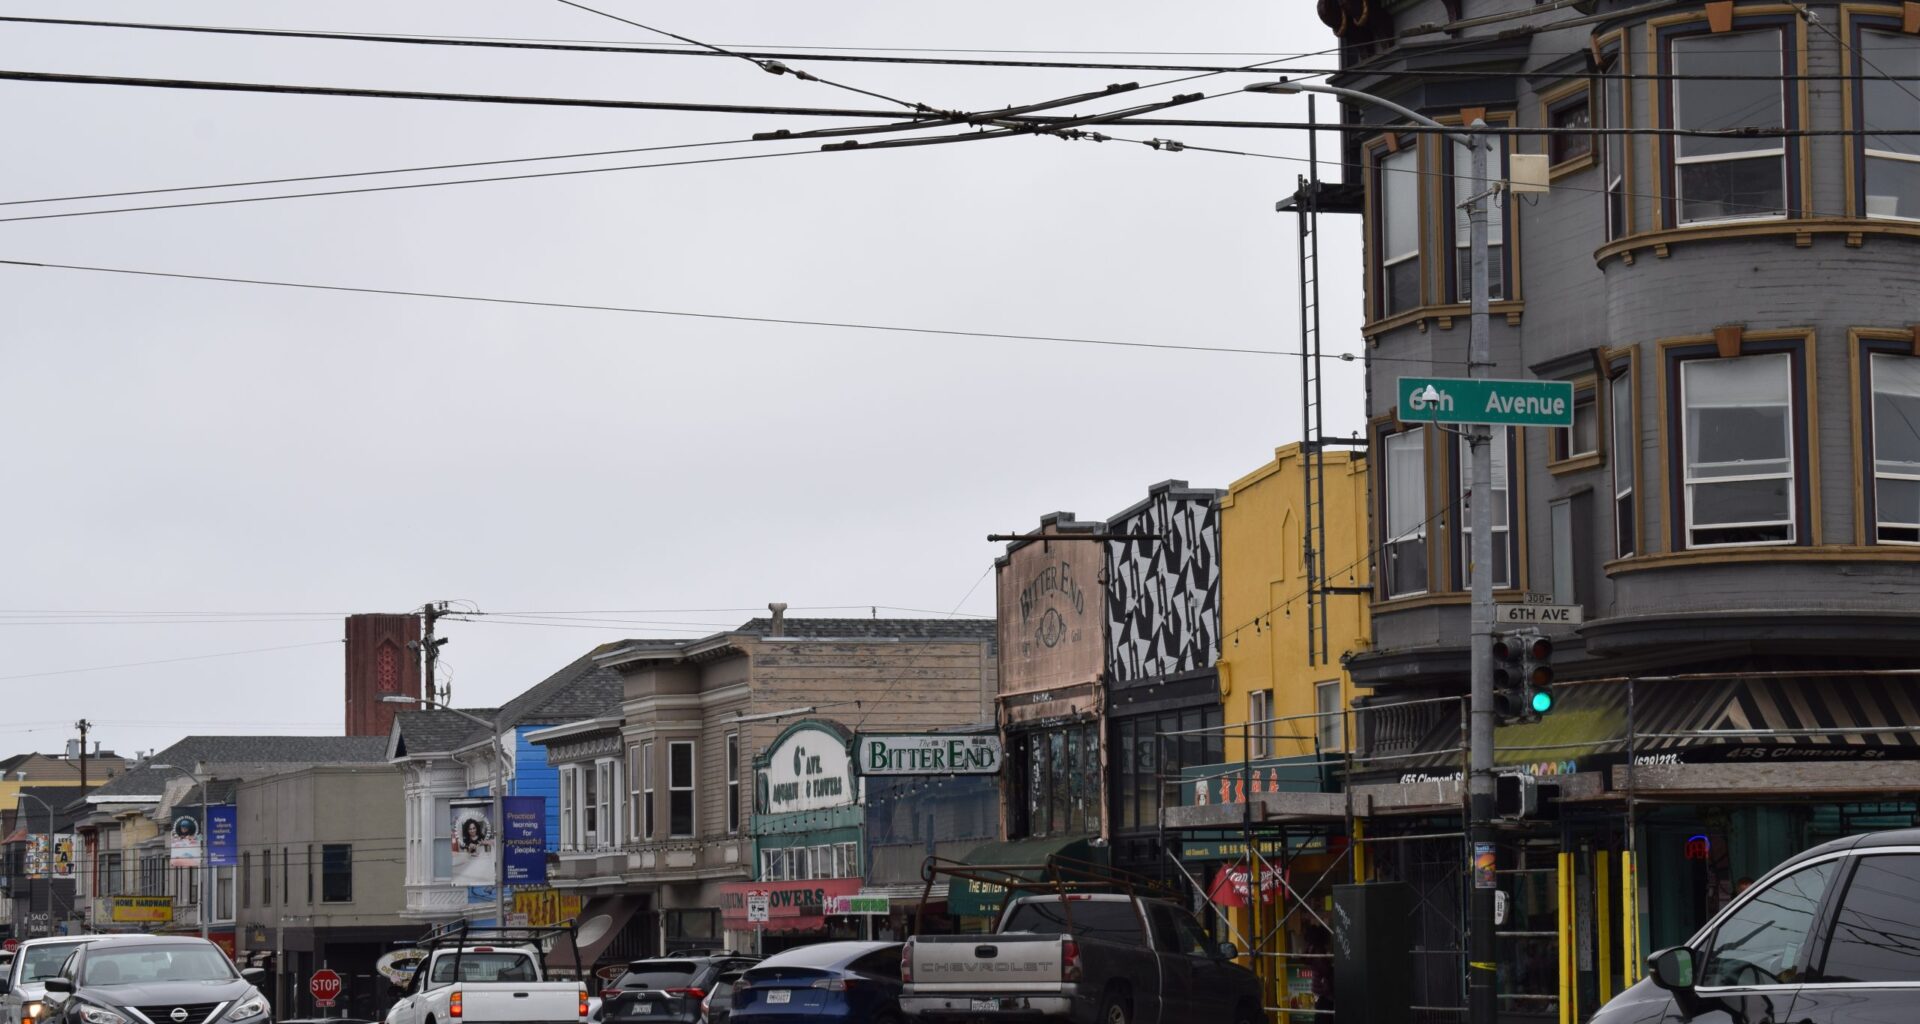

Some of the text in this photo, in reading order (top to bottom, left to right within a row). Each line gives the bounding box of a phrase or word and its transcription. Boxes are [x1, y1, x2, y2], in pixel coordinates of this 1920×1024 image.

[1485, 391, 1565, 415] Avenue
[1509, 608, 1569, 621] 6TH AVE
[868, 739, 995, 771] BITTER END
[813, 776, 842, 798] FLOWERS
[968, 879, 981, 893] THE
[769, 889, 825, 908] OWERS
[921, 962, 1054, 972] CHEVROLET
[312, 979, 339, 991] STOP
